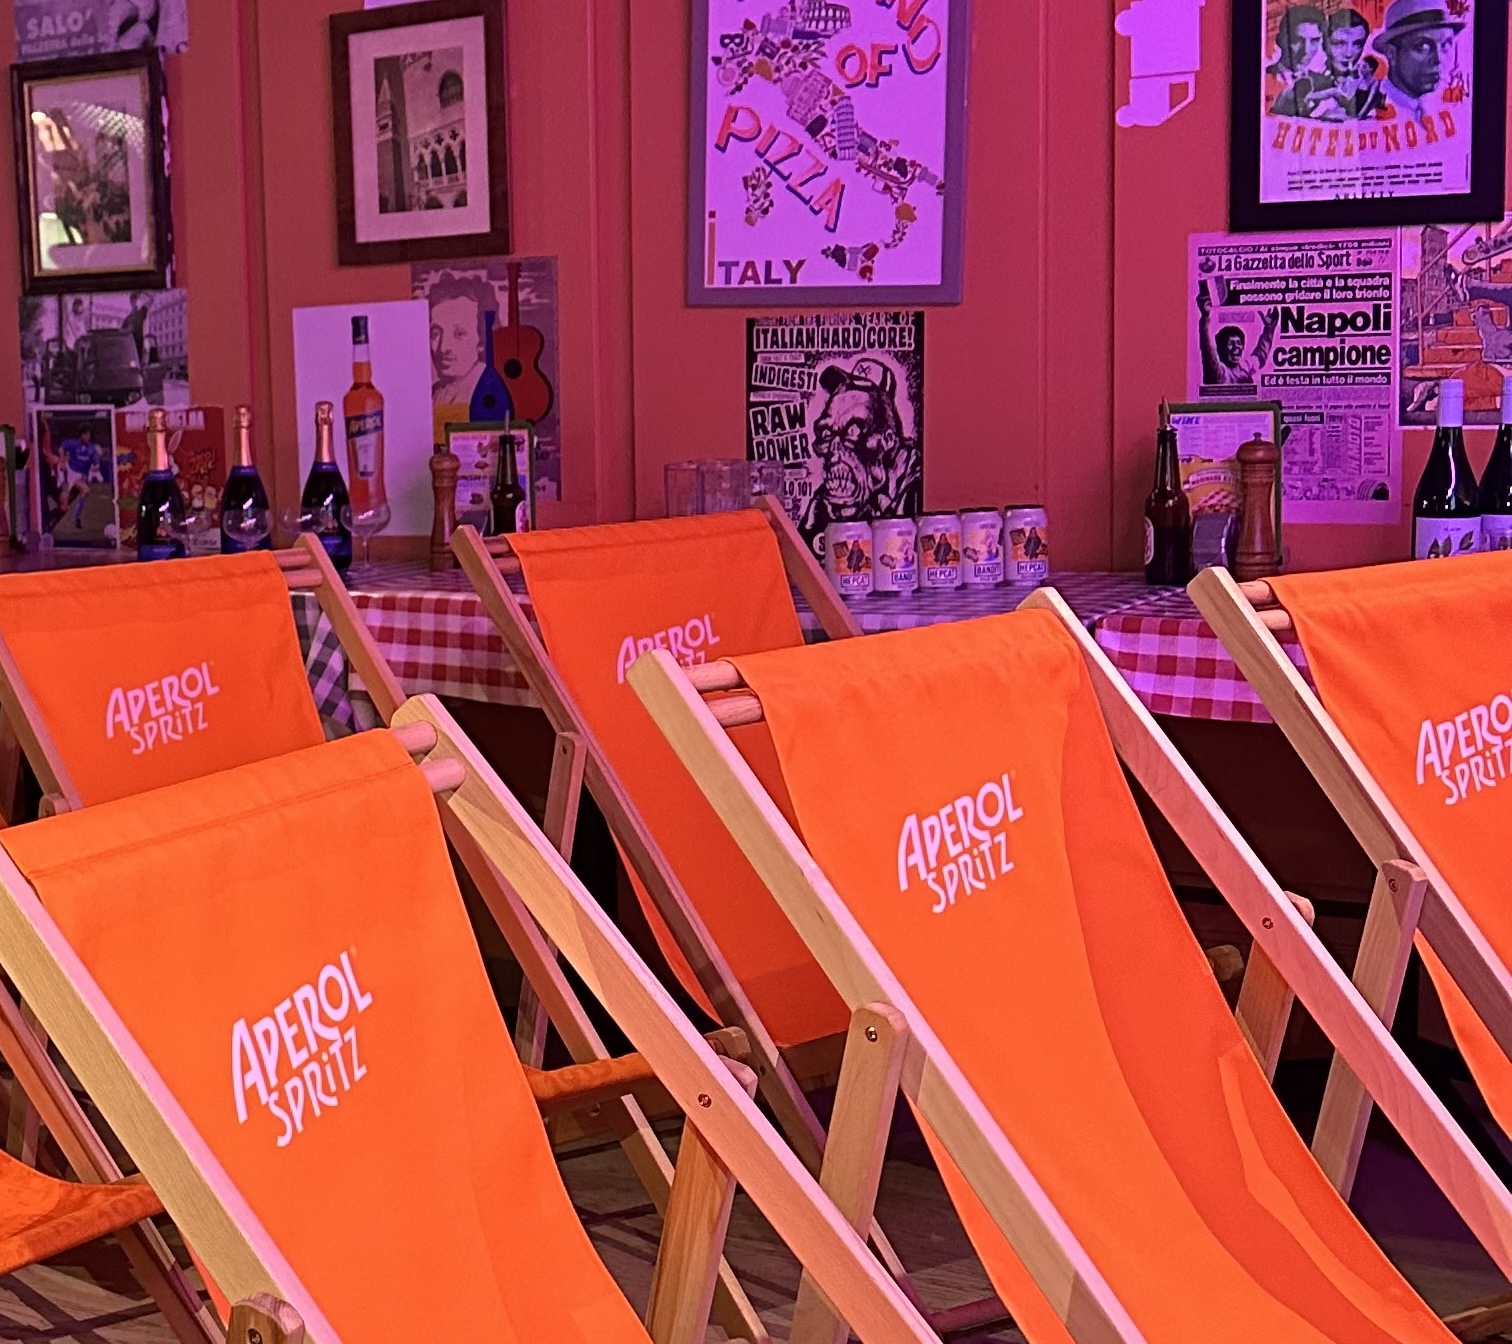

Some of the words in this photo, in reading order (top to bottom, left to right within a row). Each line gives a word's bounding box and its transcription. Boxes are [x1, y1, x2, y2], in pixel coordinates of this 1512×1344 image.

[835, 42, 898, 88] OF
[1272, 121, 1354, 157] HOTEL
[1383, 109, 1456, 153] NORD
[715, 103, 846, 234] PIZZA
[1217, 256, 1232, 272] La
[1233, 254, 1286, 272] Gazzetta
[1288, 252, 1315, 269] dello
[1317, 250, 1352, 269] Sport
[1230, 277, 1286, 291] Finalmente
[1288, 277, 1298, 289] la
[1335, 276, 1346, 287] la
[1347, 275, 1390, 289] squadra
[1239, 292, 1284, 305] possono
[1285, 289, 1322, 303] gridare
[1332, 287, 1353, 299] loro
[1355, 286, 1390, 299] trionfo
[754, 325, 818, 350] ITALIAN
[819, 325, 863, 350] HARD
[865, 324, 916, 350] CORE!
[1280, 302, 1392, 338] Napoli
[1273, 338, 1392, 372] campione
[752, 364, 818, 391] INDIGESTI
[1264, 375, 1276, 386] Ed
[1286, 374, 1310, 385] festa
[1311, 374, 1321, 385] in
[1322, 374, 1345, 385] tutto
[1354, 373, 1388, 385] mondo
[750, 402, 807, 436] RAW
[753, 434, 811, 462] POWER
[105, 661, 220, 739] APEROL
[1416, 689, 1512, 785] APERO
[897, 772, 1024, 893] APEROL
[230, 950, 373, 1125] APEROL
